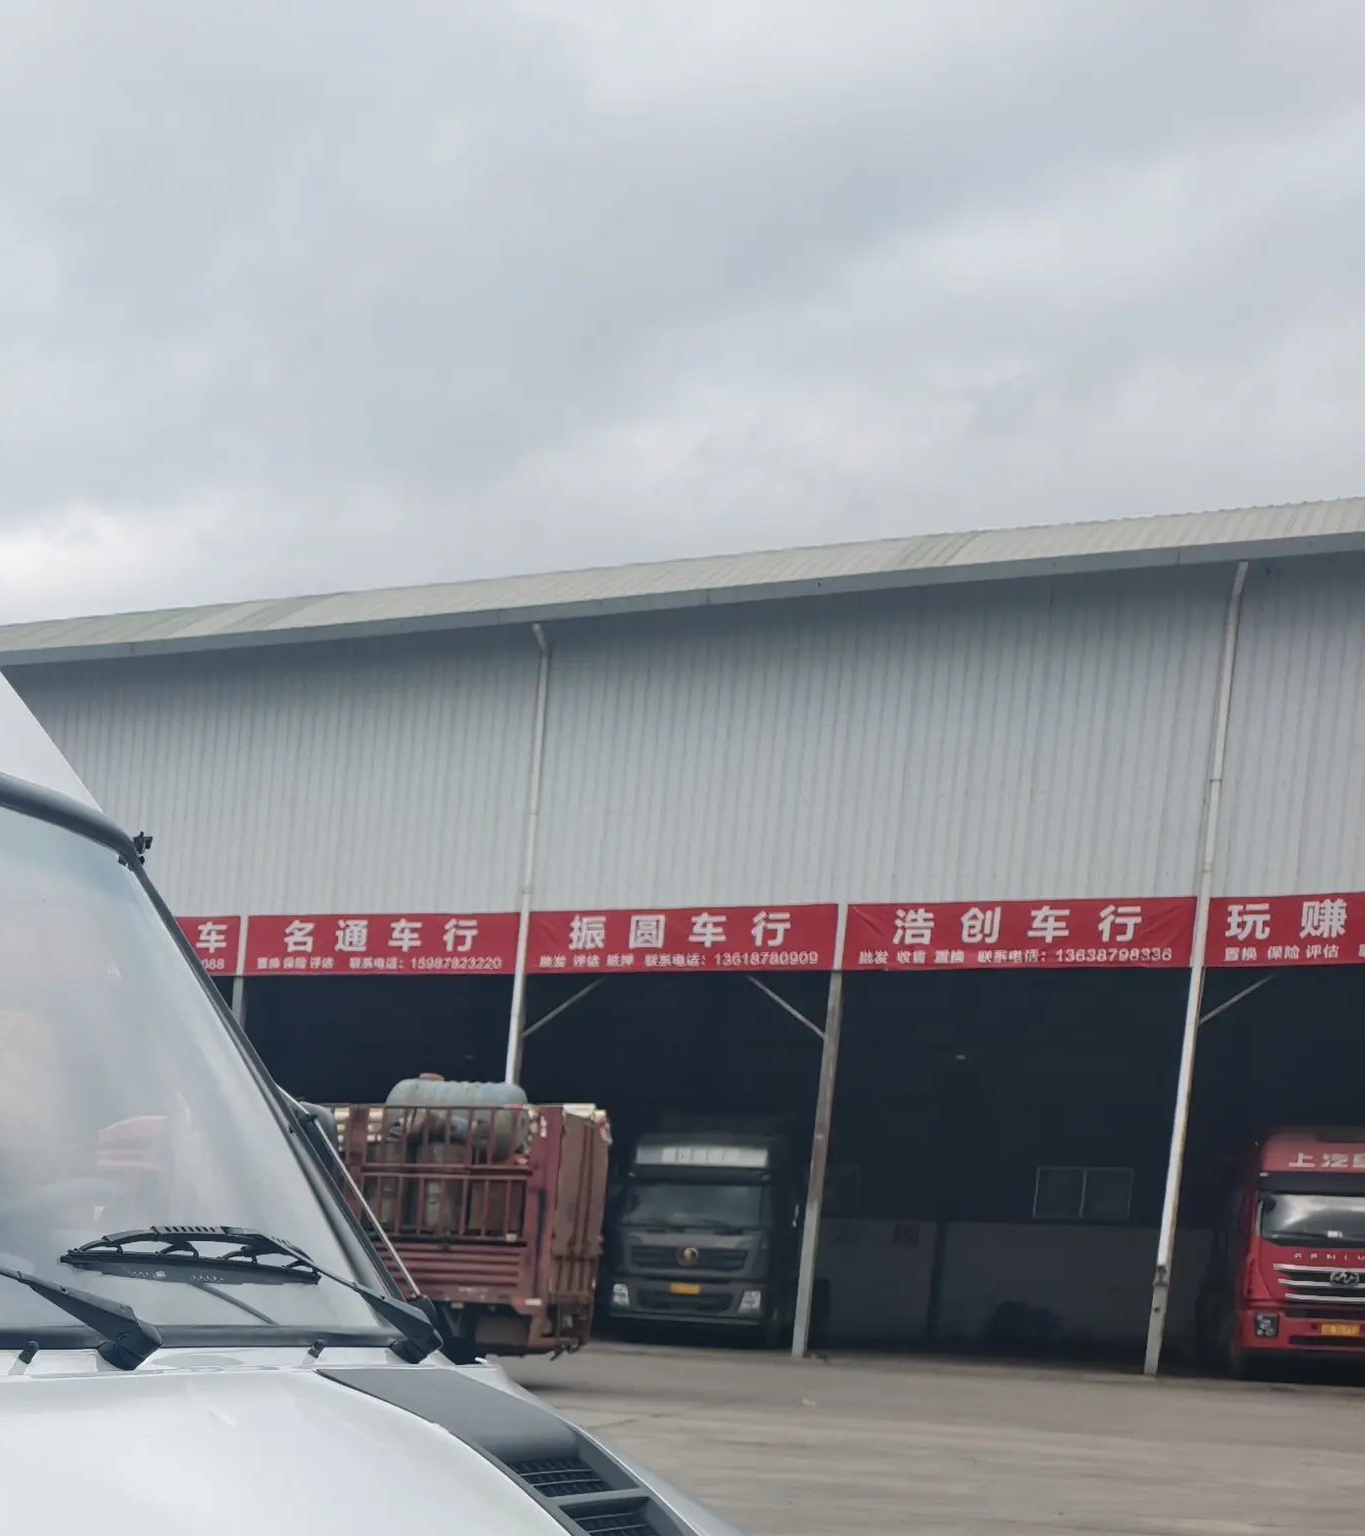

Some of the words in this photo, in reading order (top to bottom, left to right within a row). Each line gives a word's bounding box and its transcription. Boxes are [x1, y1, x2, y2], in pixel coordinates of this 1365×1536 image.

[195, 921, 229, 953] 车
[283, 918, 478, 952] 名通车行
[569, 910, 791, 950] 振圆车行
[892, 904, 1142, 945] 浩创车行
[1225, 898, 1347, 941] 玩赚
